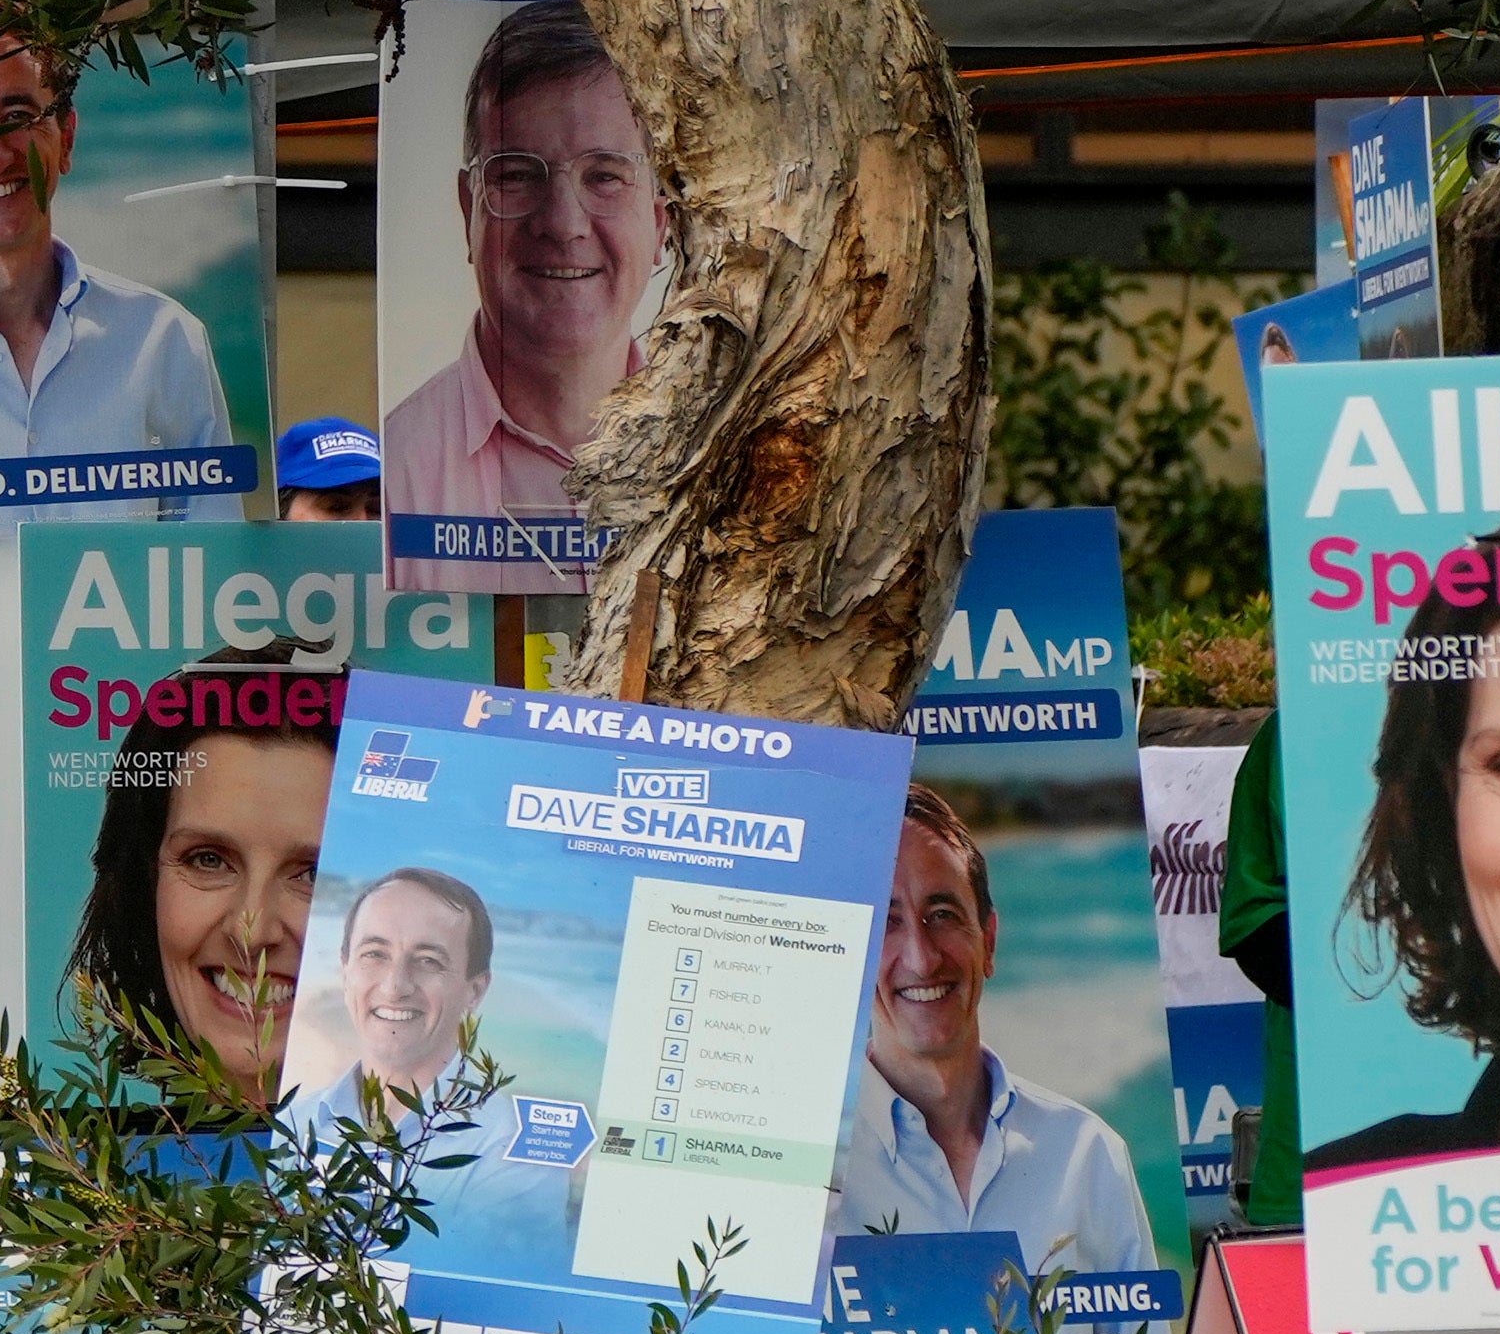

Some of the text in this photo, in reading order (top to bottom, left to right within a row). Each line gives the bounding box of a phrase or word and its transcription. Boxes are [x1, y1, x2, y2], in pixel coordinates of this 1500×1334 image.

[1352, 135, 1386, 193] DAVE
[1355, 181, 1418, 261] SHARMA
[26, 459, 234, 495] DELIVERING.
[48, 547, 470, 668] Allegra
[1044, 638, 1113, 678] MP
[524, 701, 793, 758] TAKE A PHOTO
[48, 752, 208, 769] WENTWORTH'S
[48, 770, 195, 789] INDEPENDENT
[352, 777, 429, 801] LIBERAL
[624, 775, 702, 799] VOTE
[516, 792, 795, 855] DAVE SHARMA
[567, 839, 734, 869] LIBERAL FOR WENTWORTH
[671, 903, 690, 915] You
[694, 907, 722, 919] must
[724, 910, 768, 926] number
[772, 917, 804, 931] every
[648, 921, 846, 955] Electoral Division of Wentworth
[684, 955, 693, 966] 5
[680, 985, 688, 995] 7
[674, 1015, 684, 1025] 6
[670, 1045, 679, 1055] 2
[665, 1075, 674, 1085] 4
[533, 1108, 573, 1123] Step 1.
[660, 1105, 670, 1115] 3
[654, 1137, 782, 1161] 1 SHARMA, Dave
[684, 1154, 720, 1165] LIBERAL
[1372, 1187, 1417, 1235] A
[1372, 1245, 1458, 1295] for
